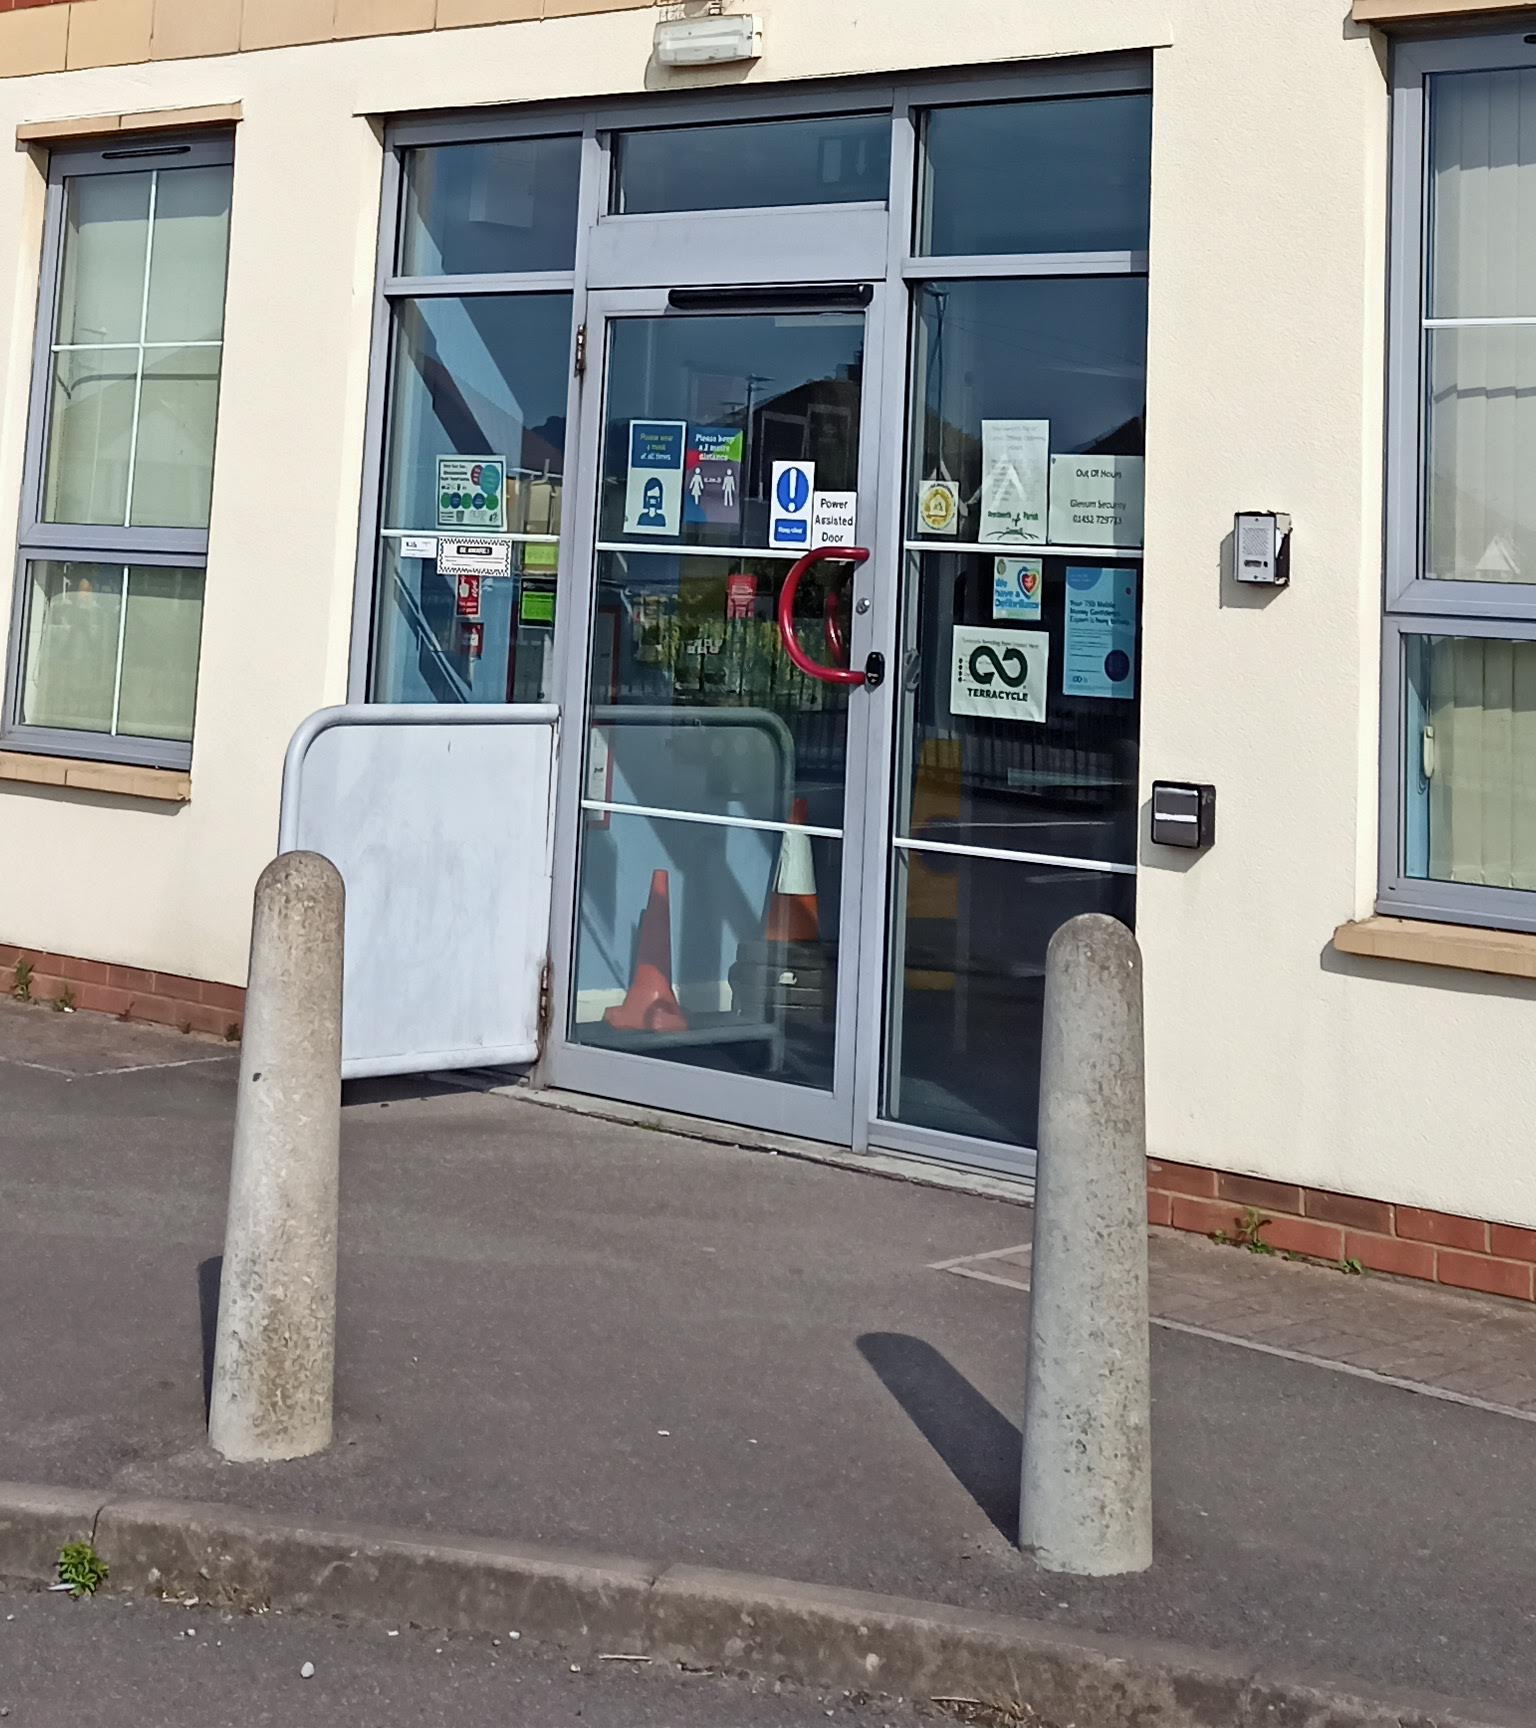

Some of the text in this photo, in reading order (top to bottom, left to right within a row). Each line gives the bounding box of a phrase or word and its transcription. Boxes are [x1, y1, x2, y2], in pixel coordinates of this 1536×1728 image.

[695, 434, 717, 442] Please
[820, 498, 848, 509] Power
[815, 515, 853, 526] Assisted
[821, 532, 844, 543] Door
[967, 688, 1028, 702] TERRACYCLE
